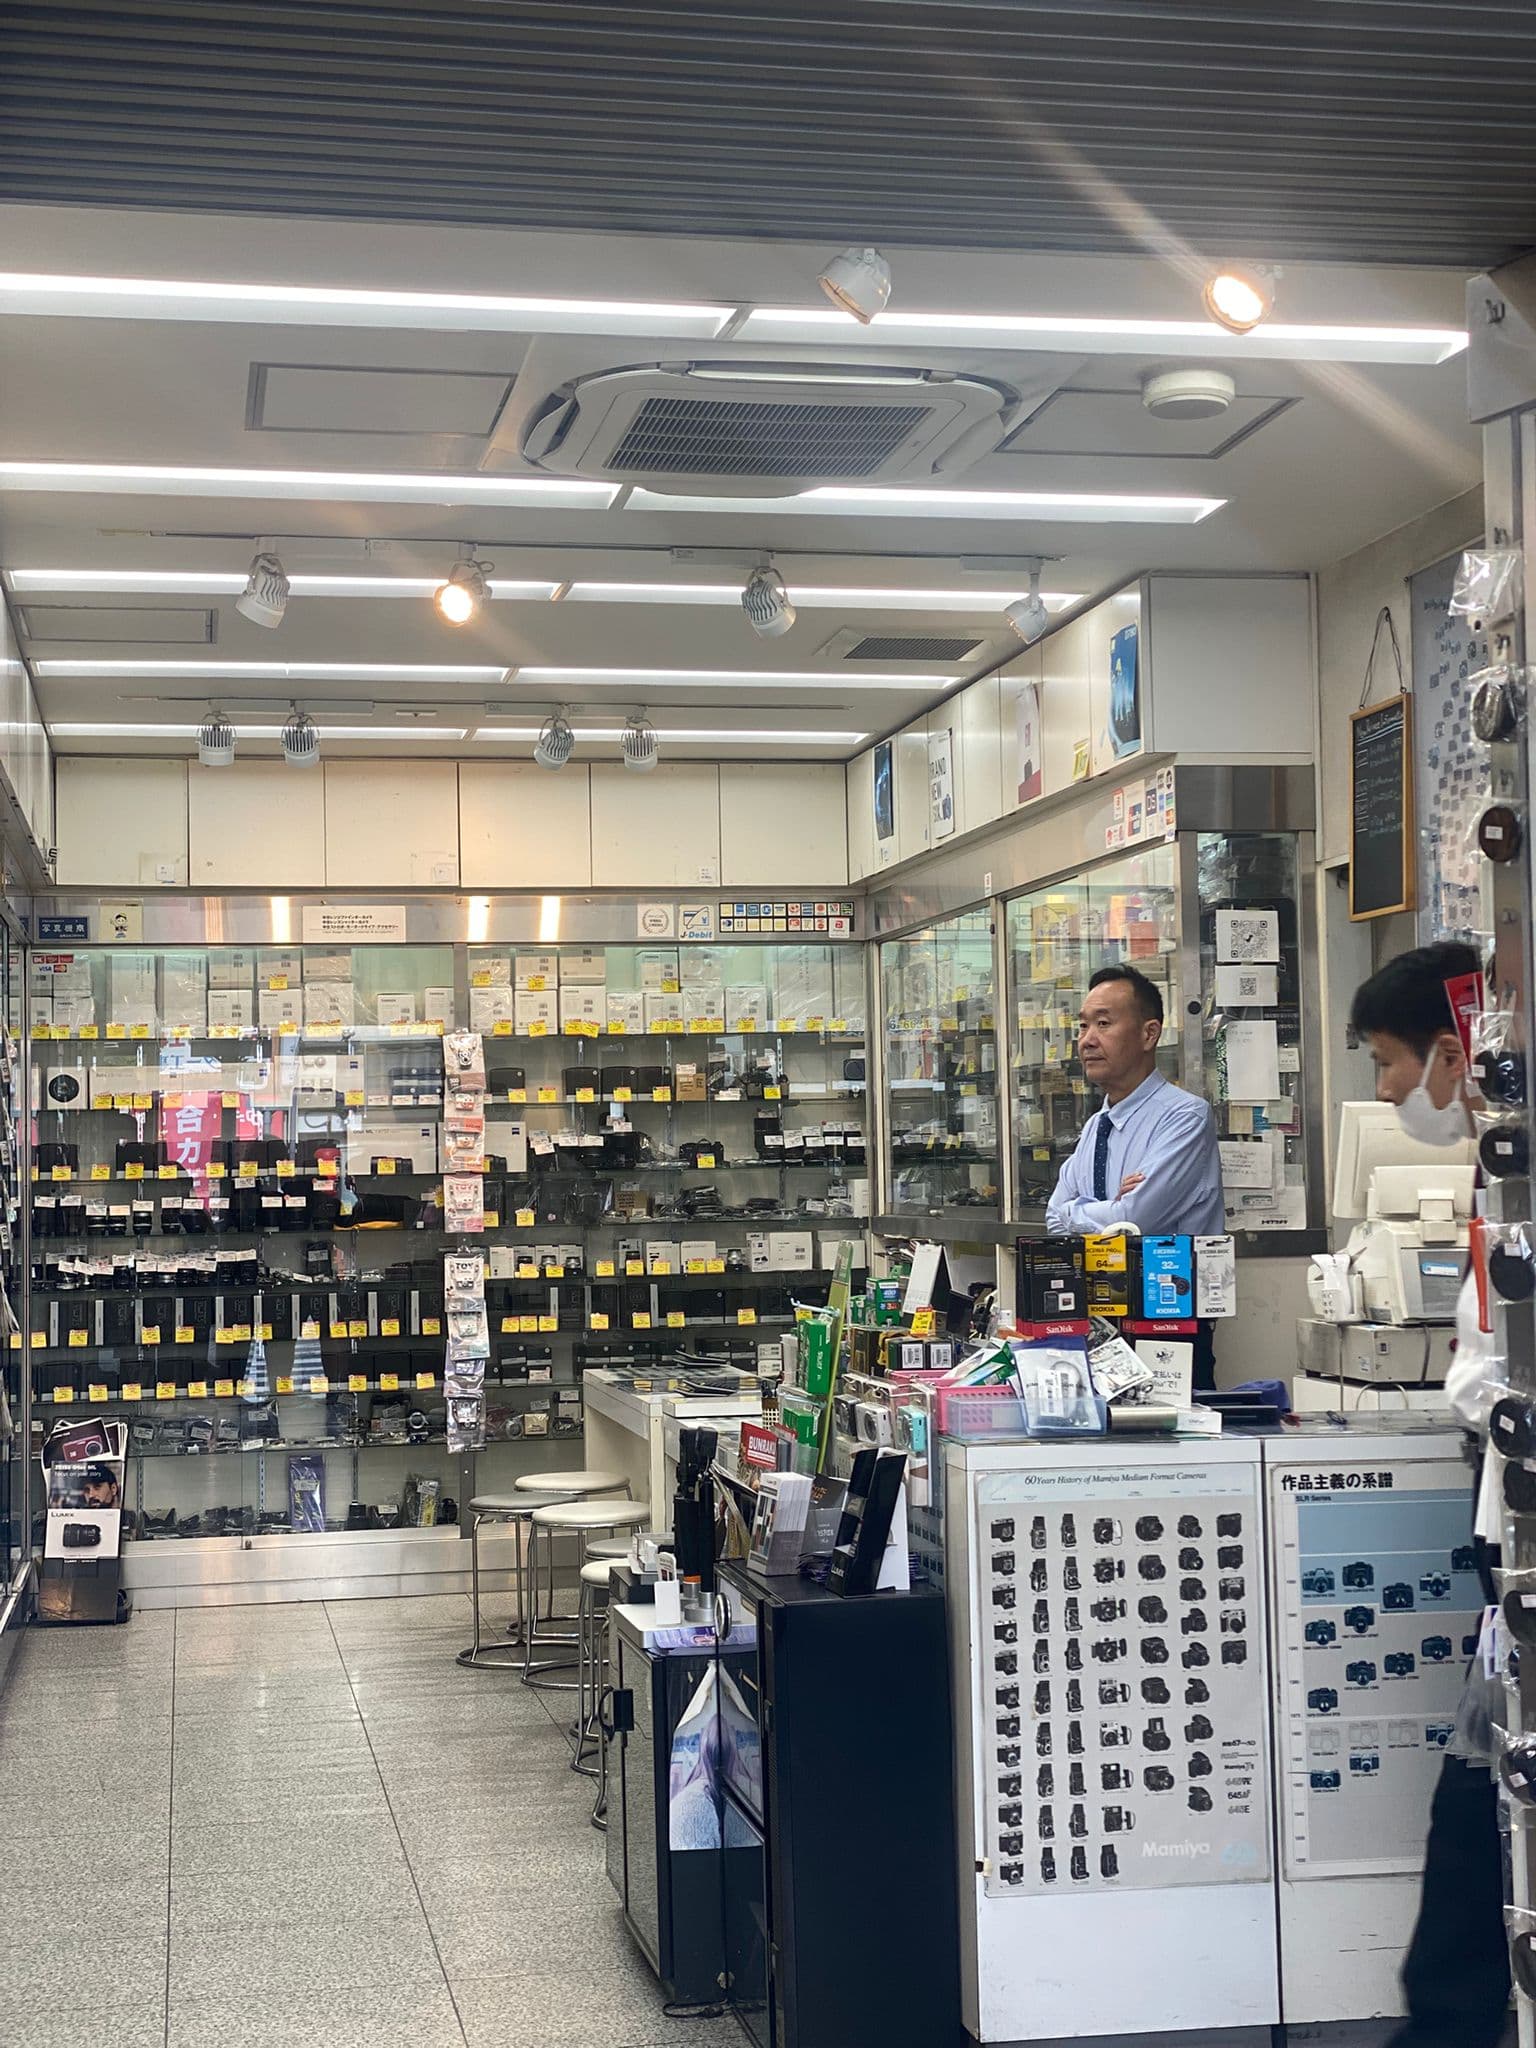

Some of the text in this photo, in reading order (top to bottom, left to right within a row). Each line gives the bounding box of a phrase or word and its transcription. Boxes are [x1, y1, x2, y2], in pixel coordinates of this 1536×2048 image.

[680, 931, 713, 939] J-Debit
[456, 1262, 474, 1270] TOY
[1046, 1325, 1074, 1335] SanDisk
[1152, 1323, 1180, 1331] SanDisk
[1057, 1475, 1082, 1485] History
[1083, 1475, 1092, 1485] of
[1092, 1474, 1120, 1483] Mamiya
[1121, 1473, 1149, 1482] Medium
[1150, 1473, 1175, 1481] Format
[1176, 1472, 1207, 1480] Cameras
[1281, 1472, 1393, 1490] 作品主義の系譜
[1142, 1839, 1211, 1859] Mamiya
